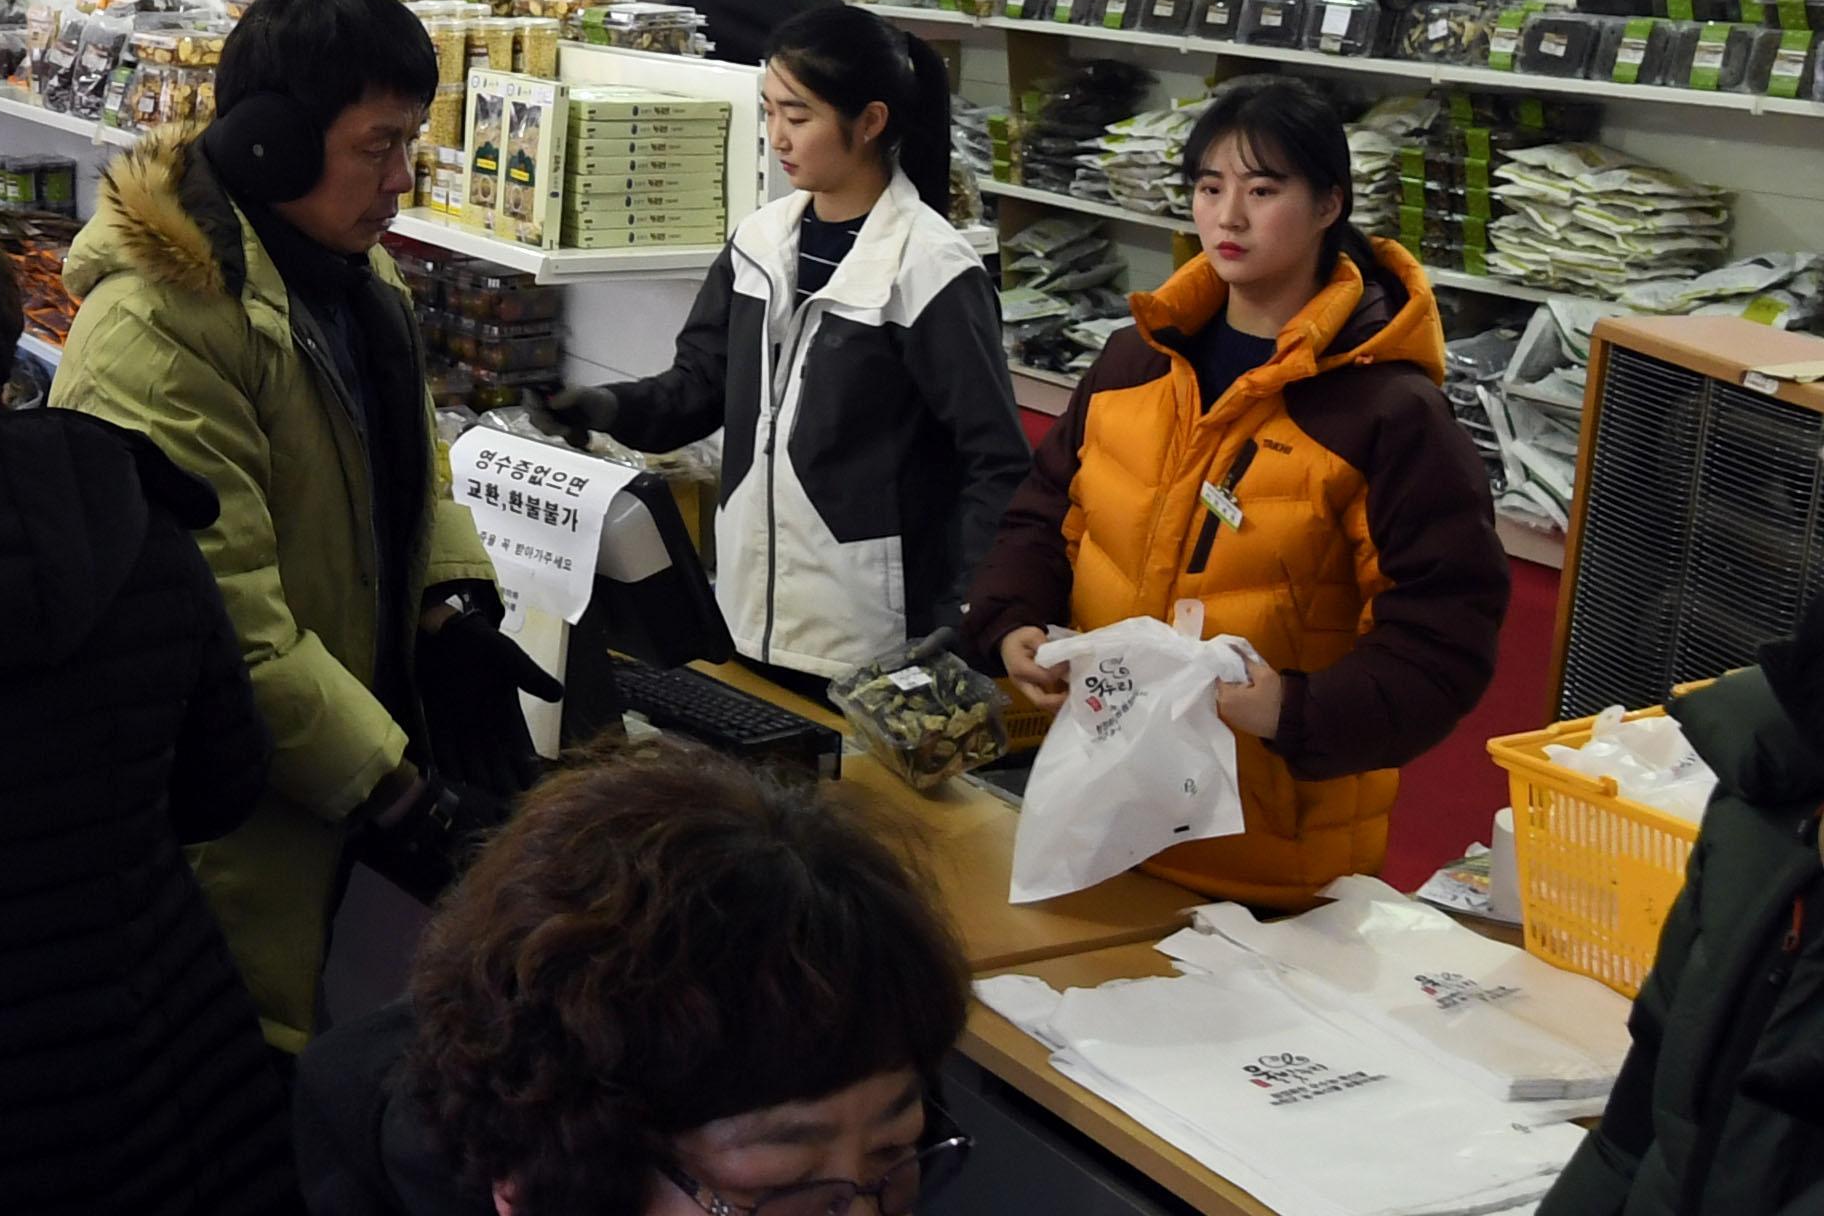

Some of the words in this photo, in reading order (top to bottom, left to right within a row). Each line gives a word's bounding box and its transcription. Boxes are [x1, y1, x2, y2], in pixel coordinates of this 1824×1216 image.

[475, 449, 590, 498] 영수증없으면
[466, 478, 579, 533] 교환,환불불가
[514, 542, 573, 572] 받아가주세요
